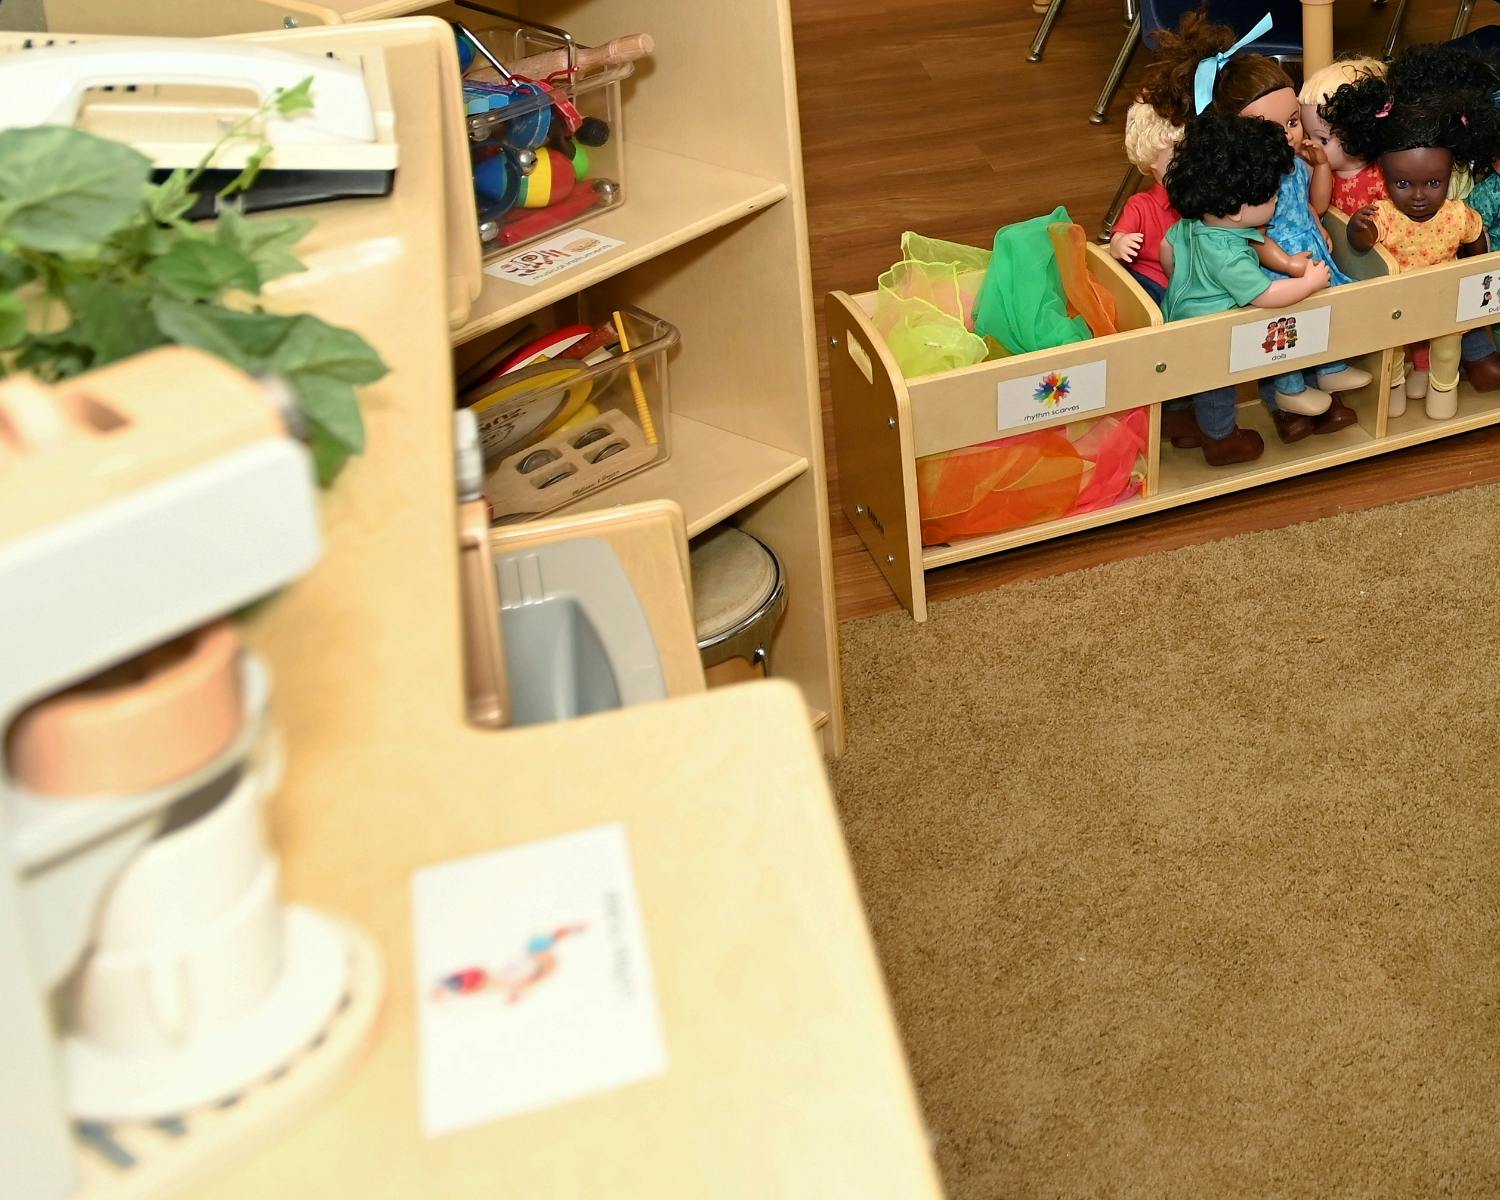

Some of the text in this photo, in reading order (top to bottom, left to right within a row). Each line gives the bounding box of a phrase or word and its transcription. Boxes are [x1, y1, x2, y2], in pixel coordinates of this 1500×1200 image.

[1271, 353, 1287, 361] dolls
[1023, 404, 1080, 422] rhythm scarves
